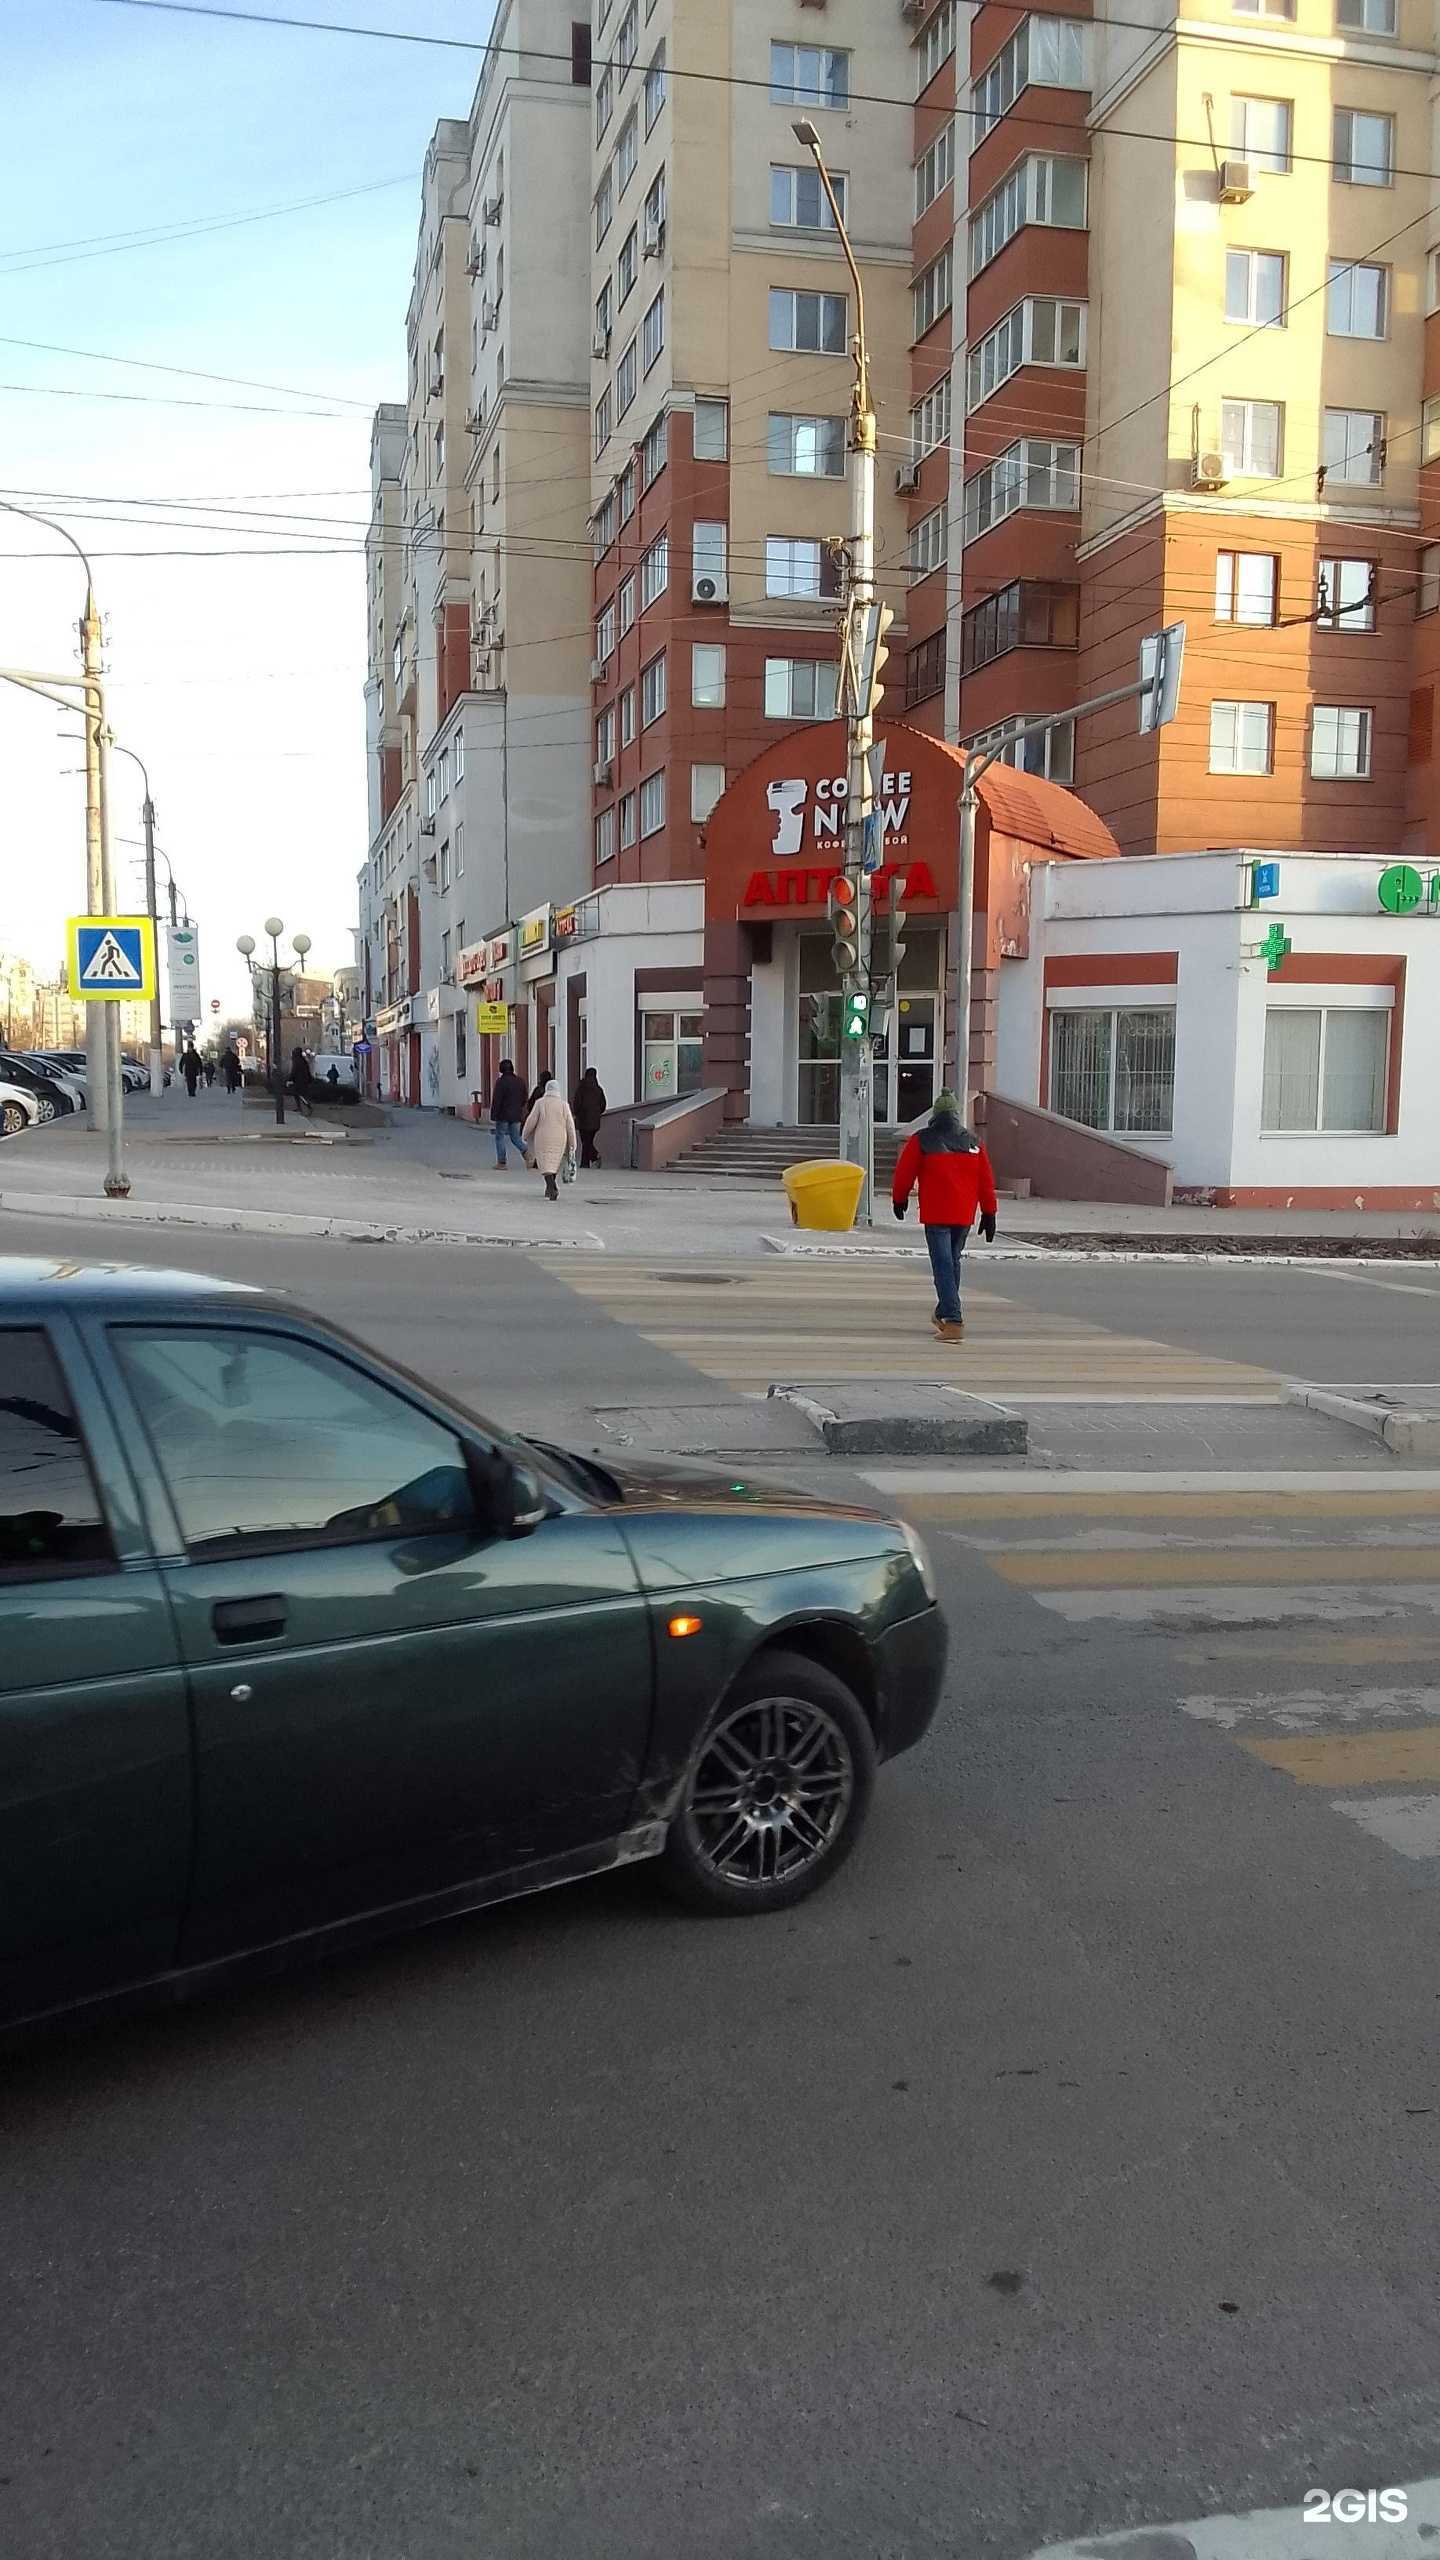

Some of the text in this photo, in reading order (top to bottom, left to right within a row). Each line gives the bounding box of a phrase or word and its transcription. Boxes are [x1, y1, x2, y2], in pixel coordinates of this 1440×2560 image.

[816, 772, 911, 800] COEE
[814, 797, 910, 836] NW
[744, 862, 938, 907] АПТКА
